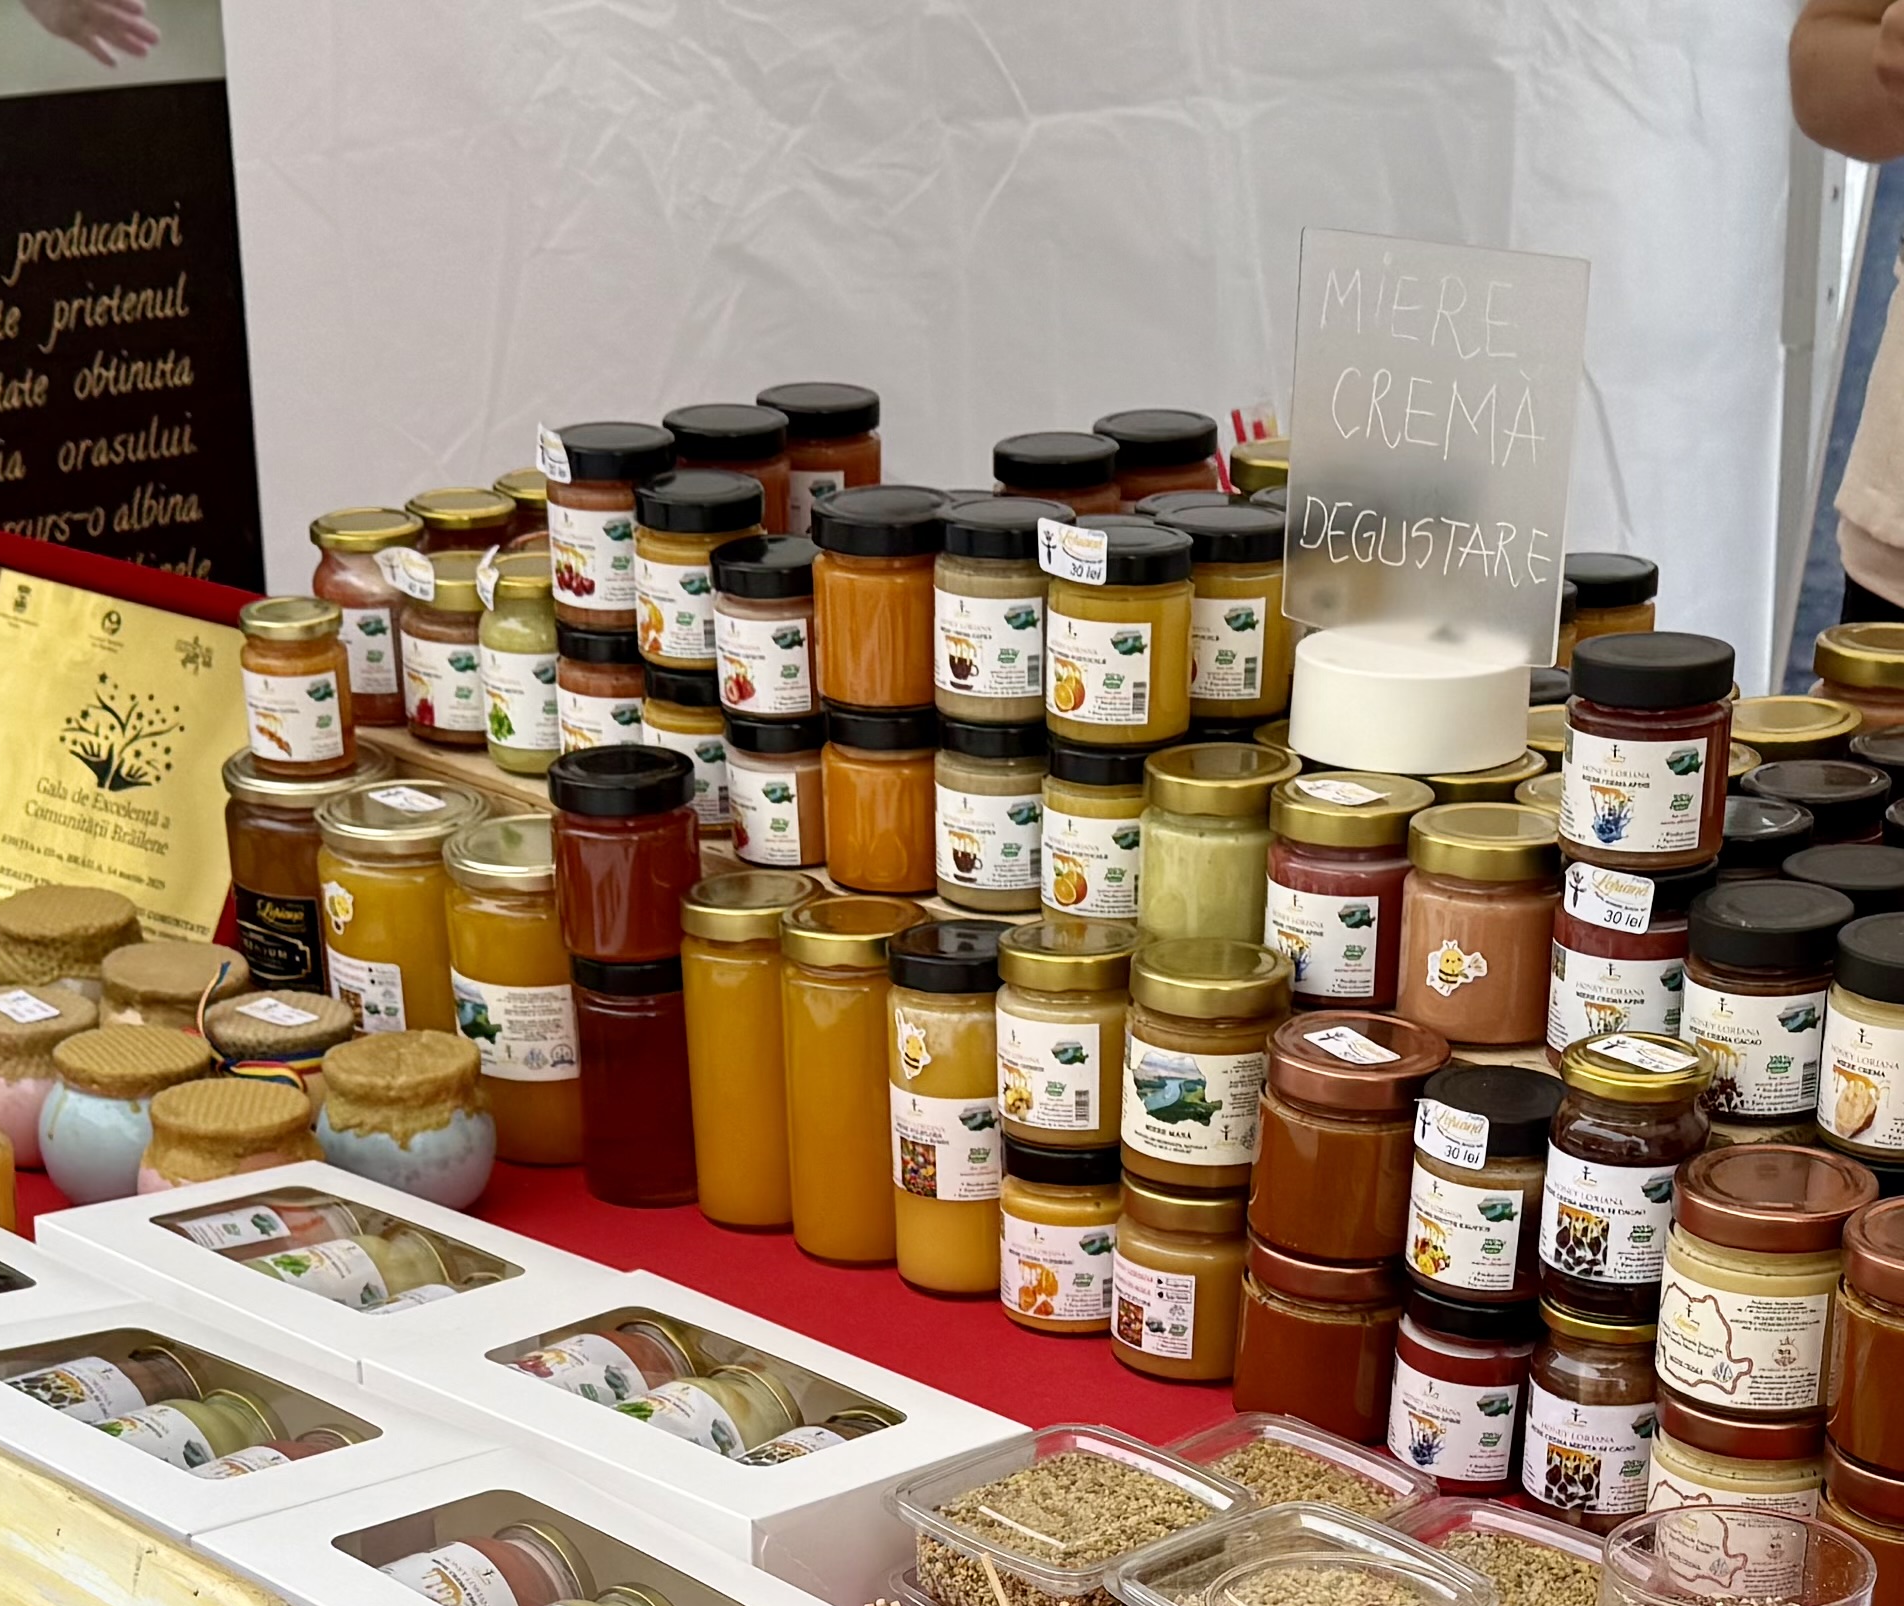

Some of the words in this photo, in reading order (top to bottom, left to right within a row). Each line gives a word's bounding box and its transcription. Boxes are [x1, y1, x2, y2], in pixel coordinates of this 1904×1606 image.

[2, 203, 184, 287] producatori
[38, 272, 189, 353] prietenul
[73, 347, 194, 399] obtinuta
[1299, 494, 1552, 588] DEGUSTARE
[1069, 562, 1084, 578] 30
[1085, 564, 1102, 580] lei
[36, 776, 69, 801] Gala
[71, 785, 90, 807] de
[159, 814, 171, 830] a
[1603, 909, 1623, 925] 30
[1625, 910, 1645, 929] lei
[1444, 1144, 1461, 1160] 30
